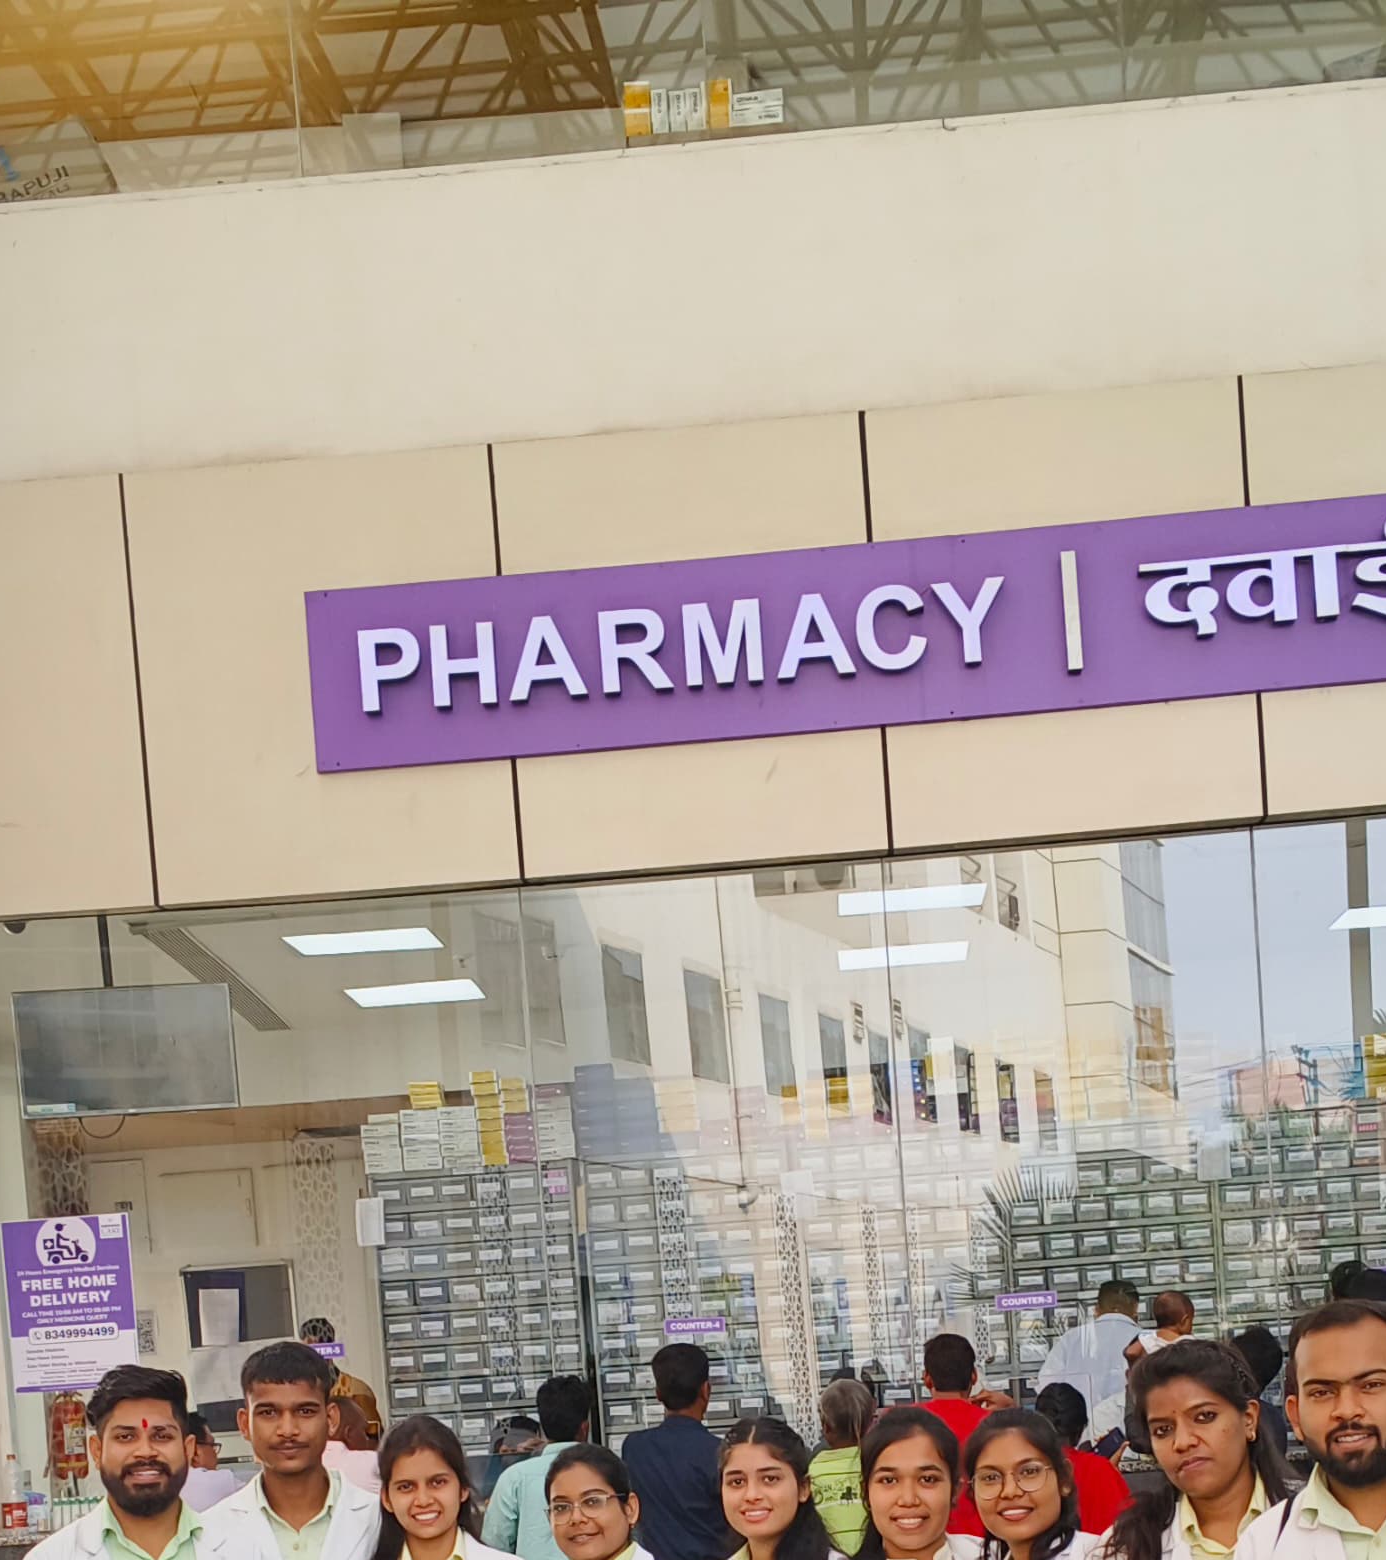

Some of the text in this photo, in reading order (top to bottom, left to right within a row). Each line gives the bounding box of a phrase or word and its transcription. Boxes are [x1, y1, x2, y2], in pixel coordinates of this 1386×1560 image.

[354, 575, 1006, 716] PHARMACY
[21, 1274, 118, 1292] FREE HOME
[29, 1290, 111, 1308] DELIVERY
[44, 1326, 115, 1341] 8349994499
[669, 1320, 720, 1331] COUNTER-4
